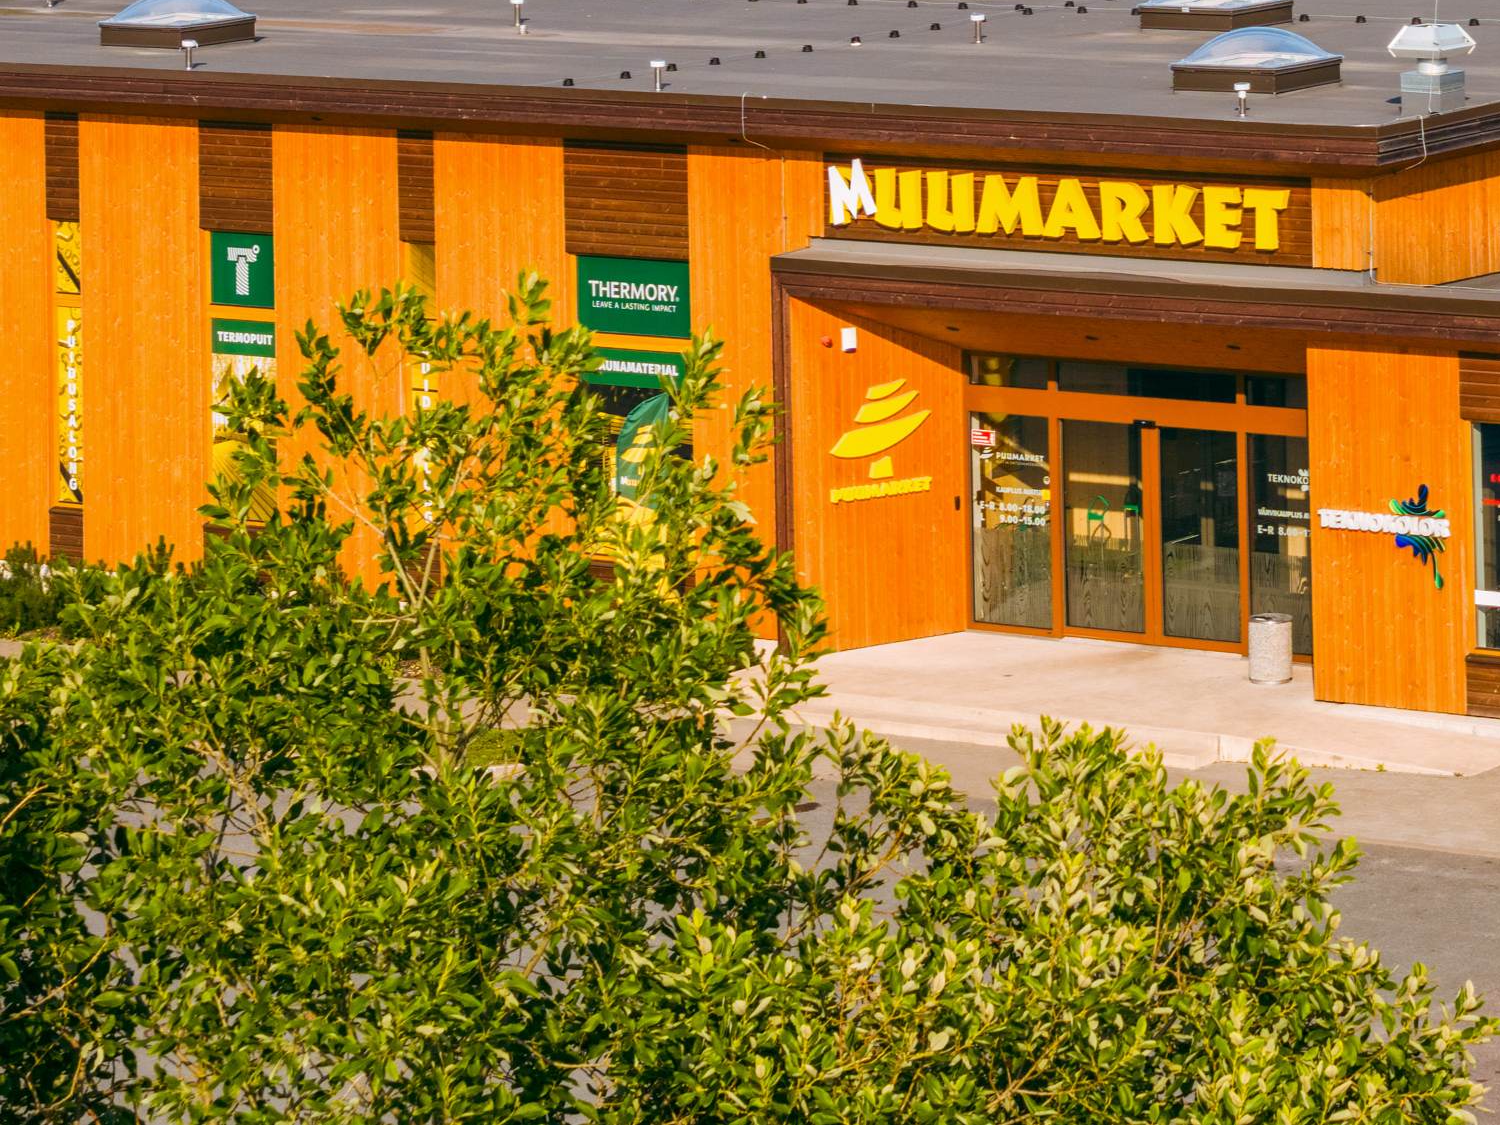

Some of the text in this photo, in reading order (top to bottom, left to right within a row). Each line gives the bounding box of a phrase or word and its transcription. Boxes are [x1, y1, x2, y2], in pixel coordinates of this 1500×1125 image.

[588, 280, 678, 302] THERMORY
[592, 300, 677, 313] LEAVE A LASTING IMPACT
[217, 330, 273, 346] TERMOPUIT
[66, 318, 79, 492] PUIDUSALONG
[995, 451, 1045, 462] PUUMARKET
[1267, 473, 1309, 485] TEKNOKO
[1257, 524, 1275, 535] E-R
[1316, 508, 1451, 538] TEKNOKOLOR
